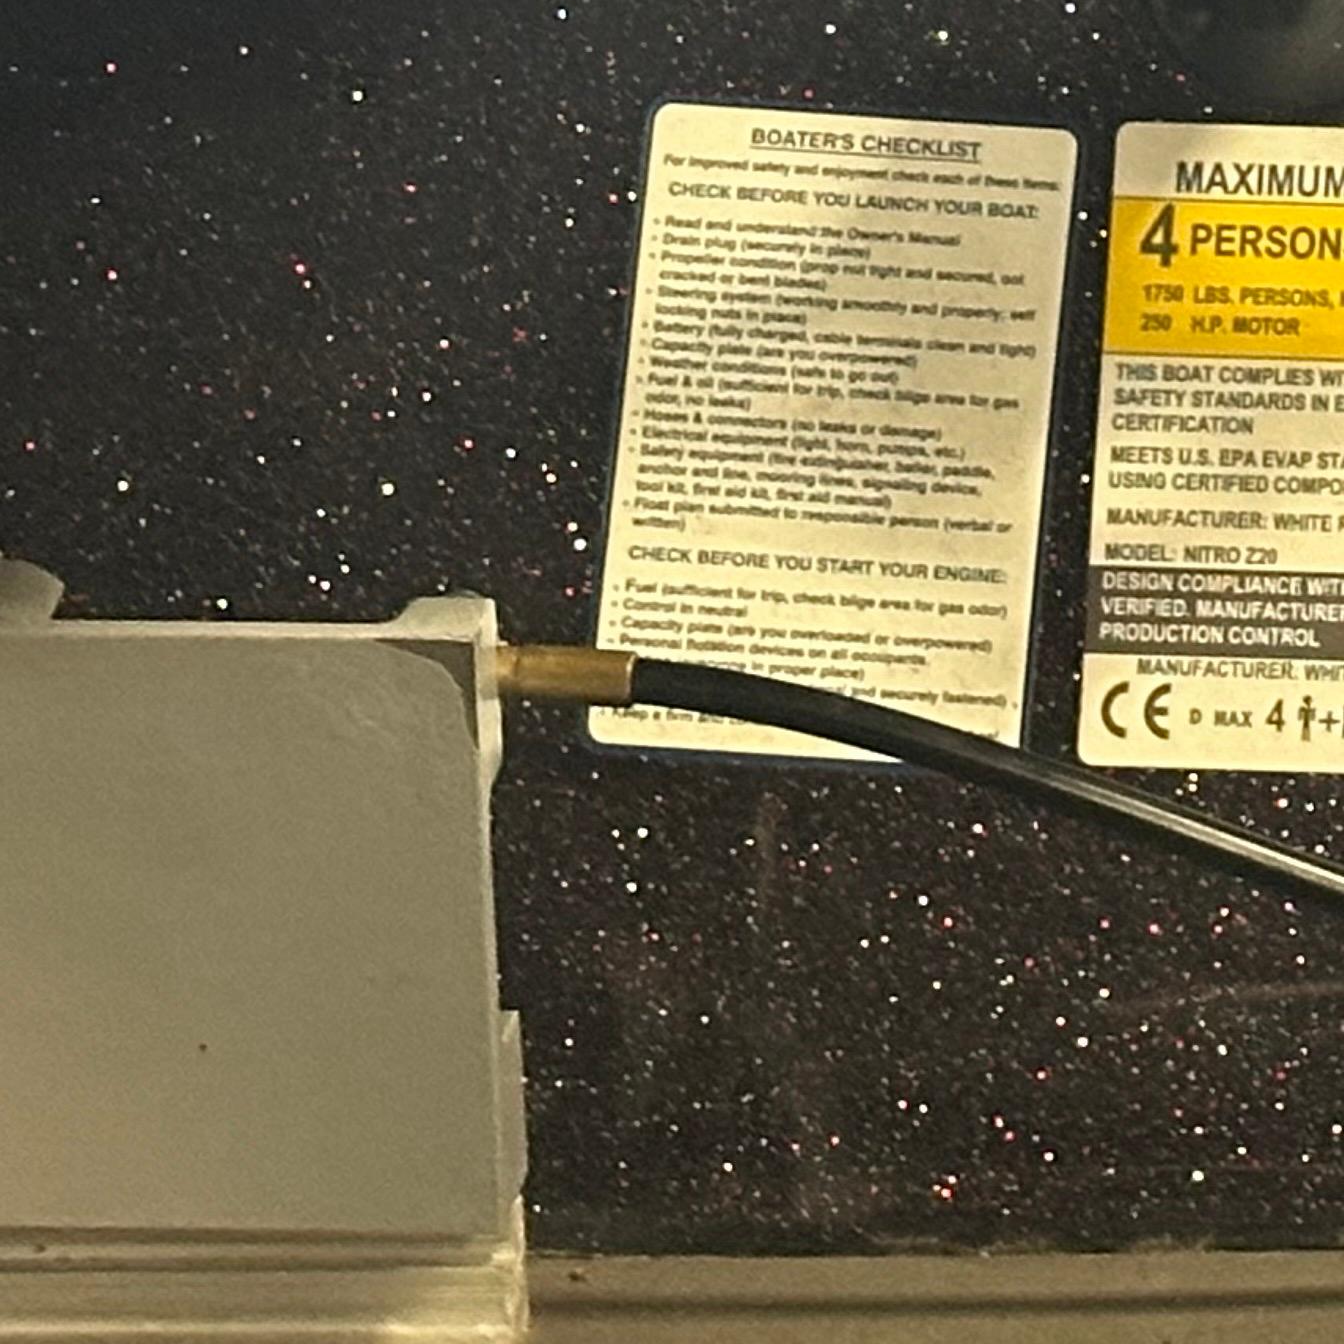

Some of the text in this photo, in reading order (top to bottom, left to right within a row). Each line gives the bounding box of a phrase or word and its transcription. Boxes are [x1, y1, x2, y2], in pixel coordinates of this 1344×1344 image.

[752, 128, 982, 158] BOATER'S CHECKLIST
[667, 181, 731, 199] CHECK
[736, 186, 807, 205] BEFORE
[812, 191, 850, 208] YOU
[853, 193, 929, 212] LAUNCH
[933, 199, 983, 216] YOUR
[1140, 202, 1180, 268] 4
[1142, 283, 1184, 302] 1750
[1140, 312, 1300, 336] 250 H.P. MOTOR
[1114, 362, 1157, 382] THIS
[1161, 363, 1214, 382] BOAT
[1217, 365, 1314, 386] COMPLIES
[1113, 387, 1186, 407] SAFETY
[1190, 389, 1306, 411] STANDARDS
[1310, 393, 1329, 412] IN
[1110, 412, 1253, 434] CERTIFICATION
[1110, 445, 1173, 465] MEETS
[1177, 447, 1214, 466] U.S.
[1218, 447, 1258, 467] EPA
[1261, 449, 1312, 468] EVAP
[1107, 470, 1166, 489] USING
[1170, 472, 1269, 493] CERTIFIED
[1272, 513, 1332, 532] WHITE
[627, 544, 691, 563] CHECK
[696, 549, 769, 568] BEFORE
[774, 554, 812, 571] YOU
[816, 556, 874, 575] START
[878, 561, 928, 579] YOUR
[1104, 542, 1277, 564] MODEL: NITRO Z20
[1101, 570, 1173, 591] DESIGN
[1176, 572, 1302, 596] COMPLIANCE
[1098, 621, 1320, 648] PRODUCTION CONTROL
[1213, 710, 1252, 728] MAX
[1265, 698, 1285, 732] 4
